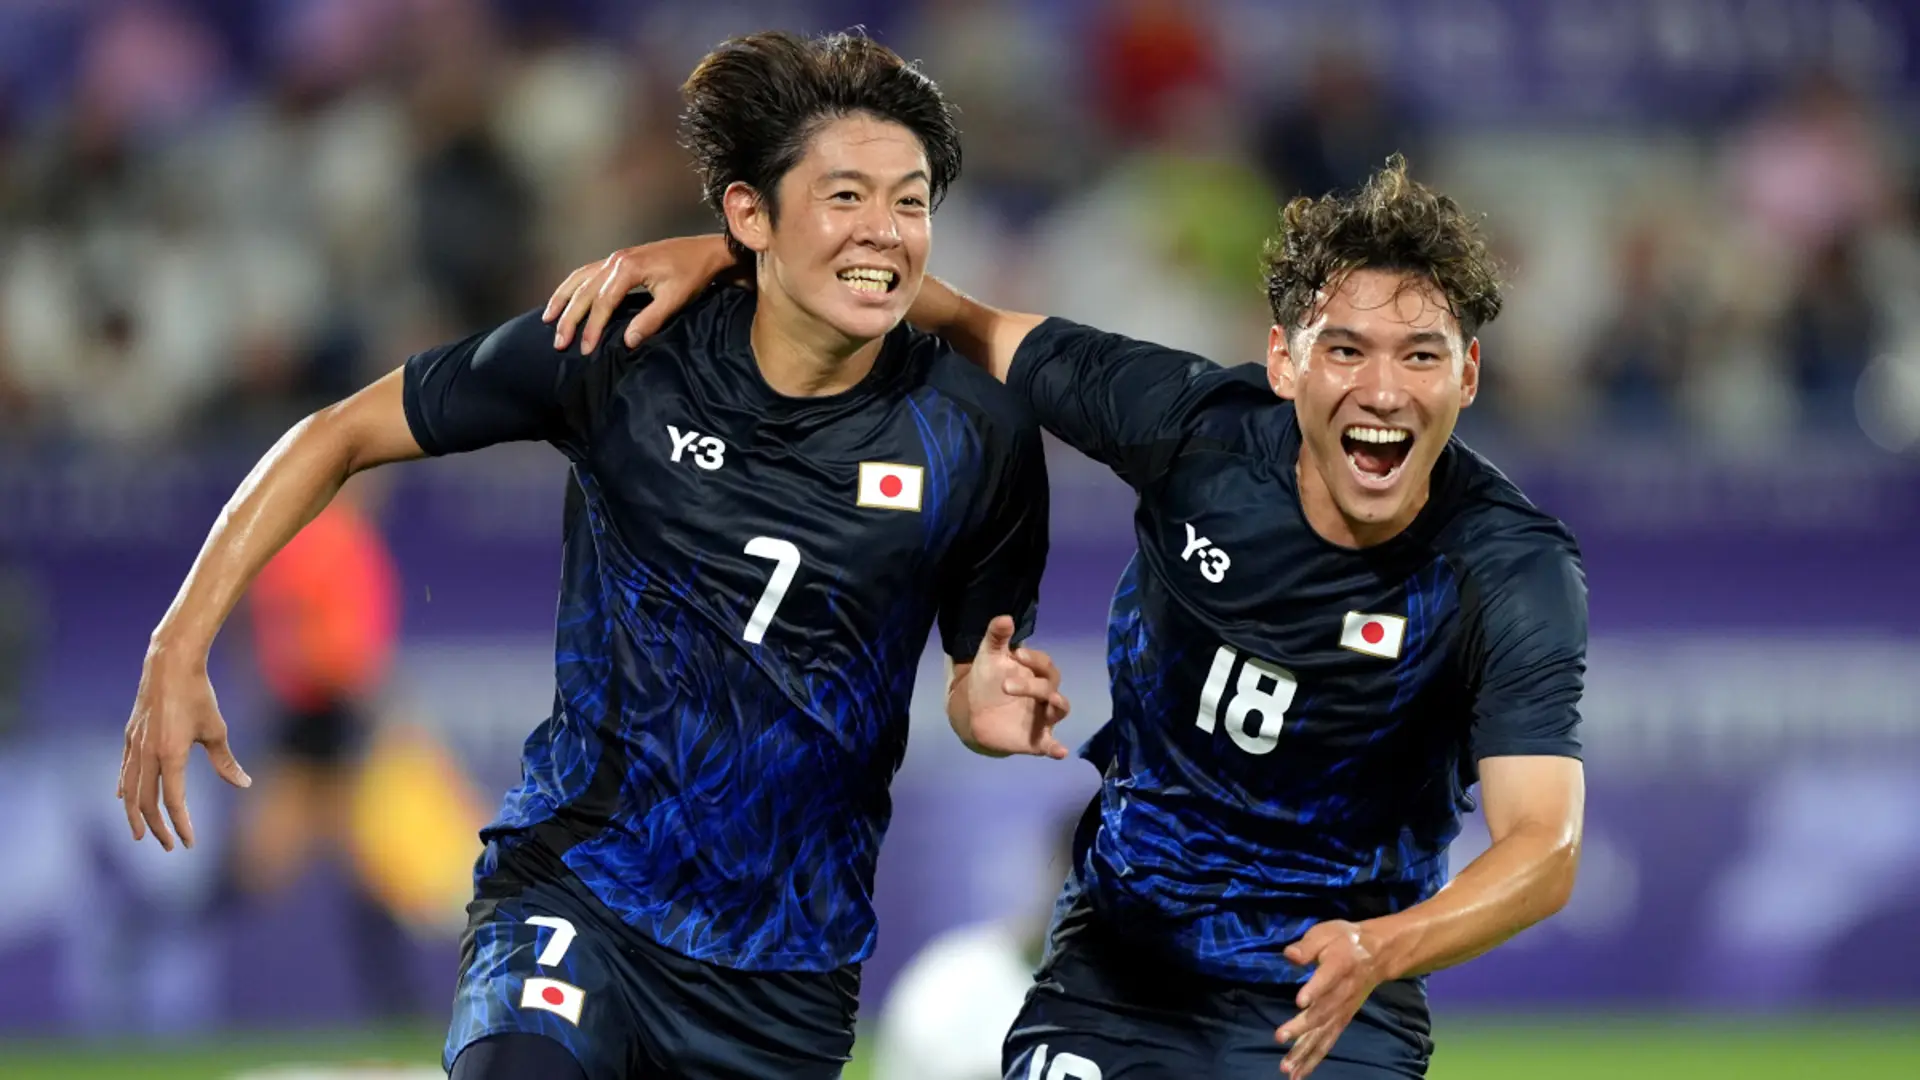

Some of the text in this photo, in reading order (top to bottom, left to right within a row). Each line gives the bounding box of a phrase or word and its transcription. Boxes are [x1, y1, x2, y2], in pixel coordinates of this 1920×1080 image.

[666, 424, 726, 471] Y-3
[1180, 522, 1231, 584] Y-3
[743, 536, 801, 645] 7
[1195, 644, 1298, 755] 18
[524, 915, 578, 967] 7
